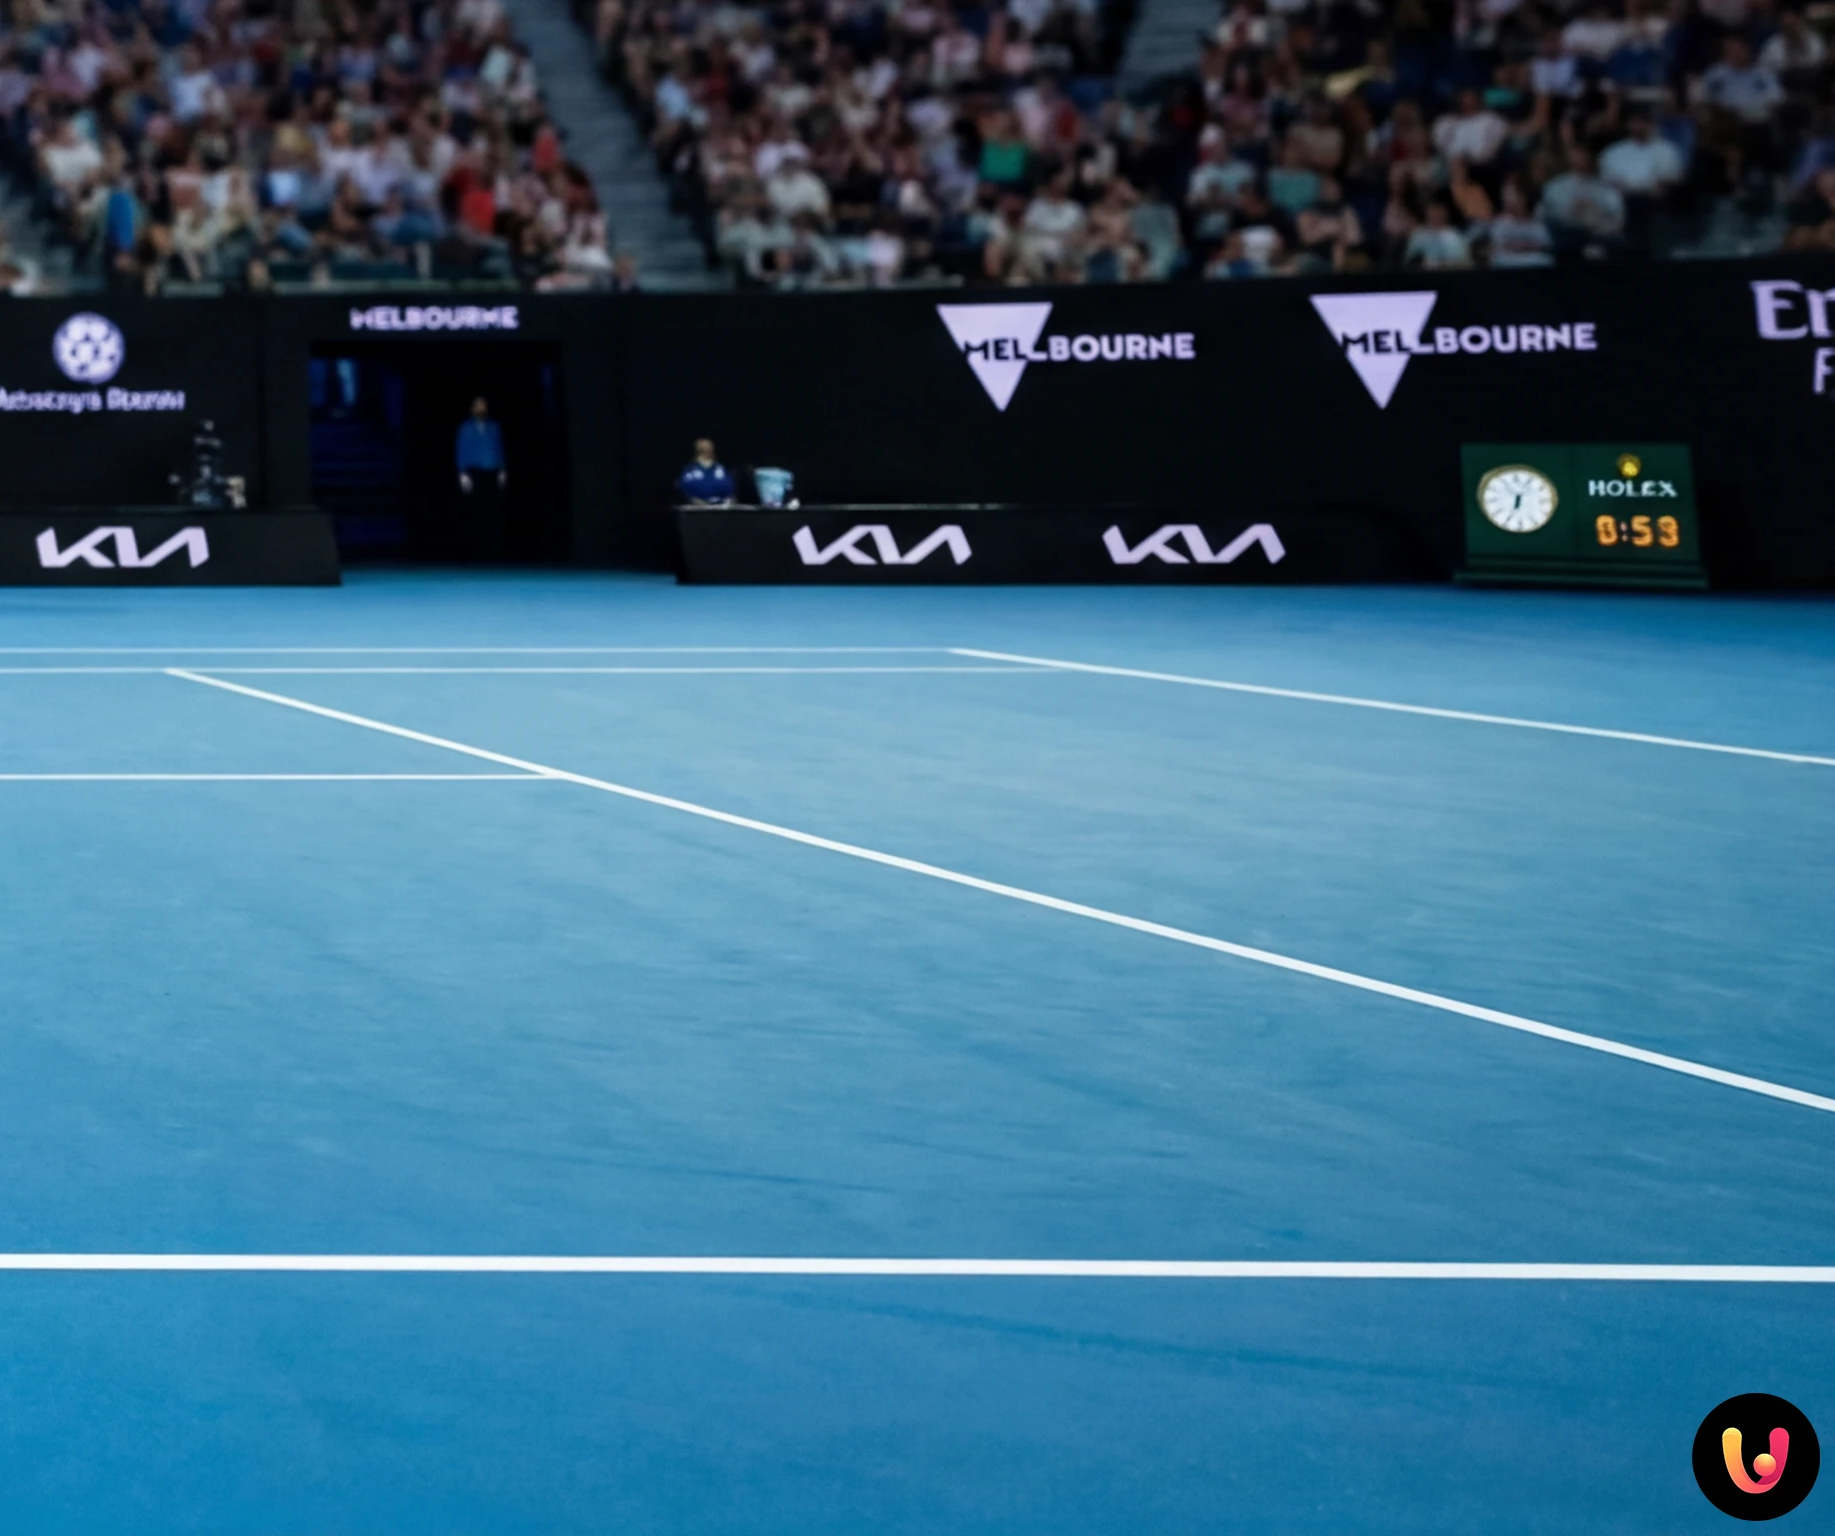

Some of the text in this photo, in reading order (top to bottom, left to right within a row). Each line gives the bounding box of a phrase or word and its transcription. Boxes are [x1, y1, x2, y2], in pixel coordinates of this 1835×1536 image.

[963, 332, 1196, 362] MELBOURNE
[1341, 322, 1598, 355] MELBOURNE
[35, 526, 210, 568] KIA
[792, 525, 973, 565] KIA
[1102, 524, 1286, 565] KIA
